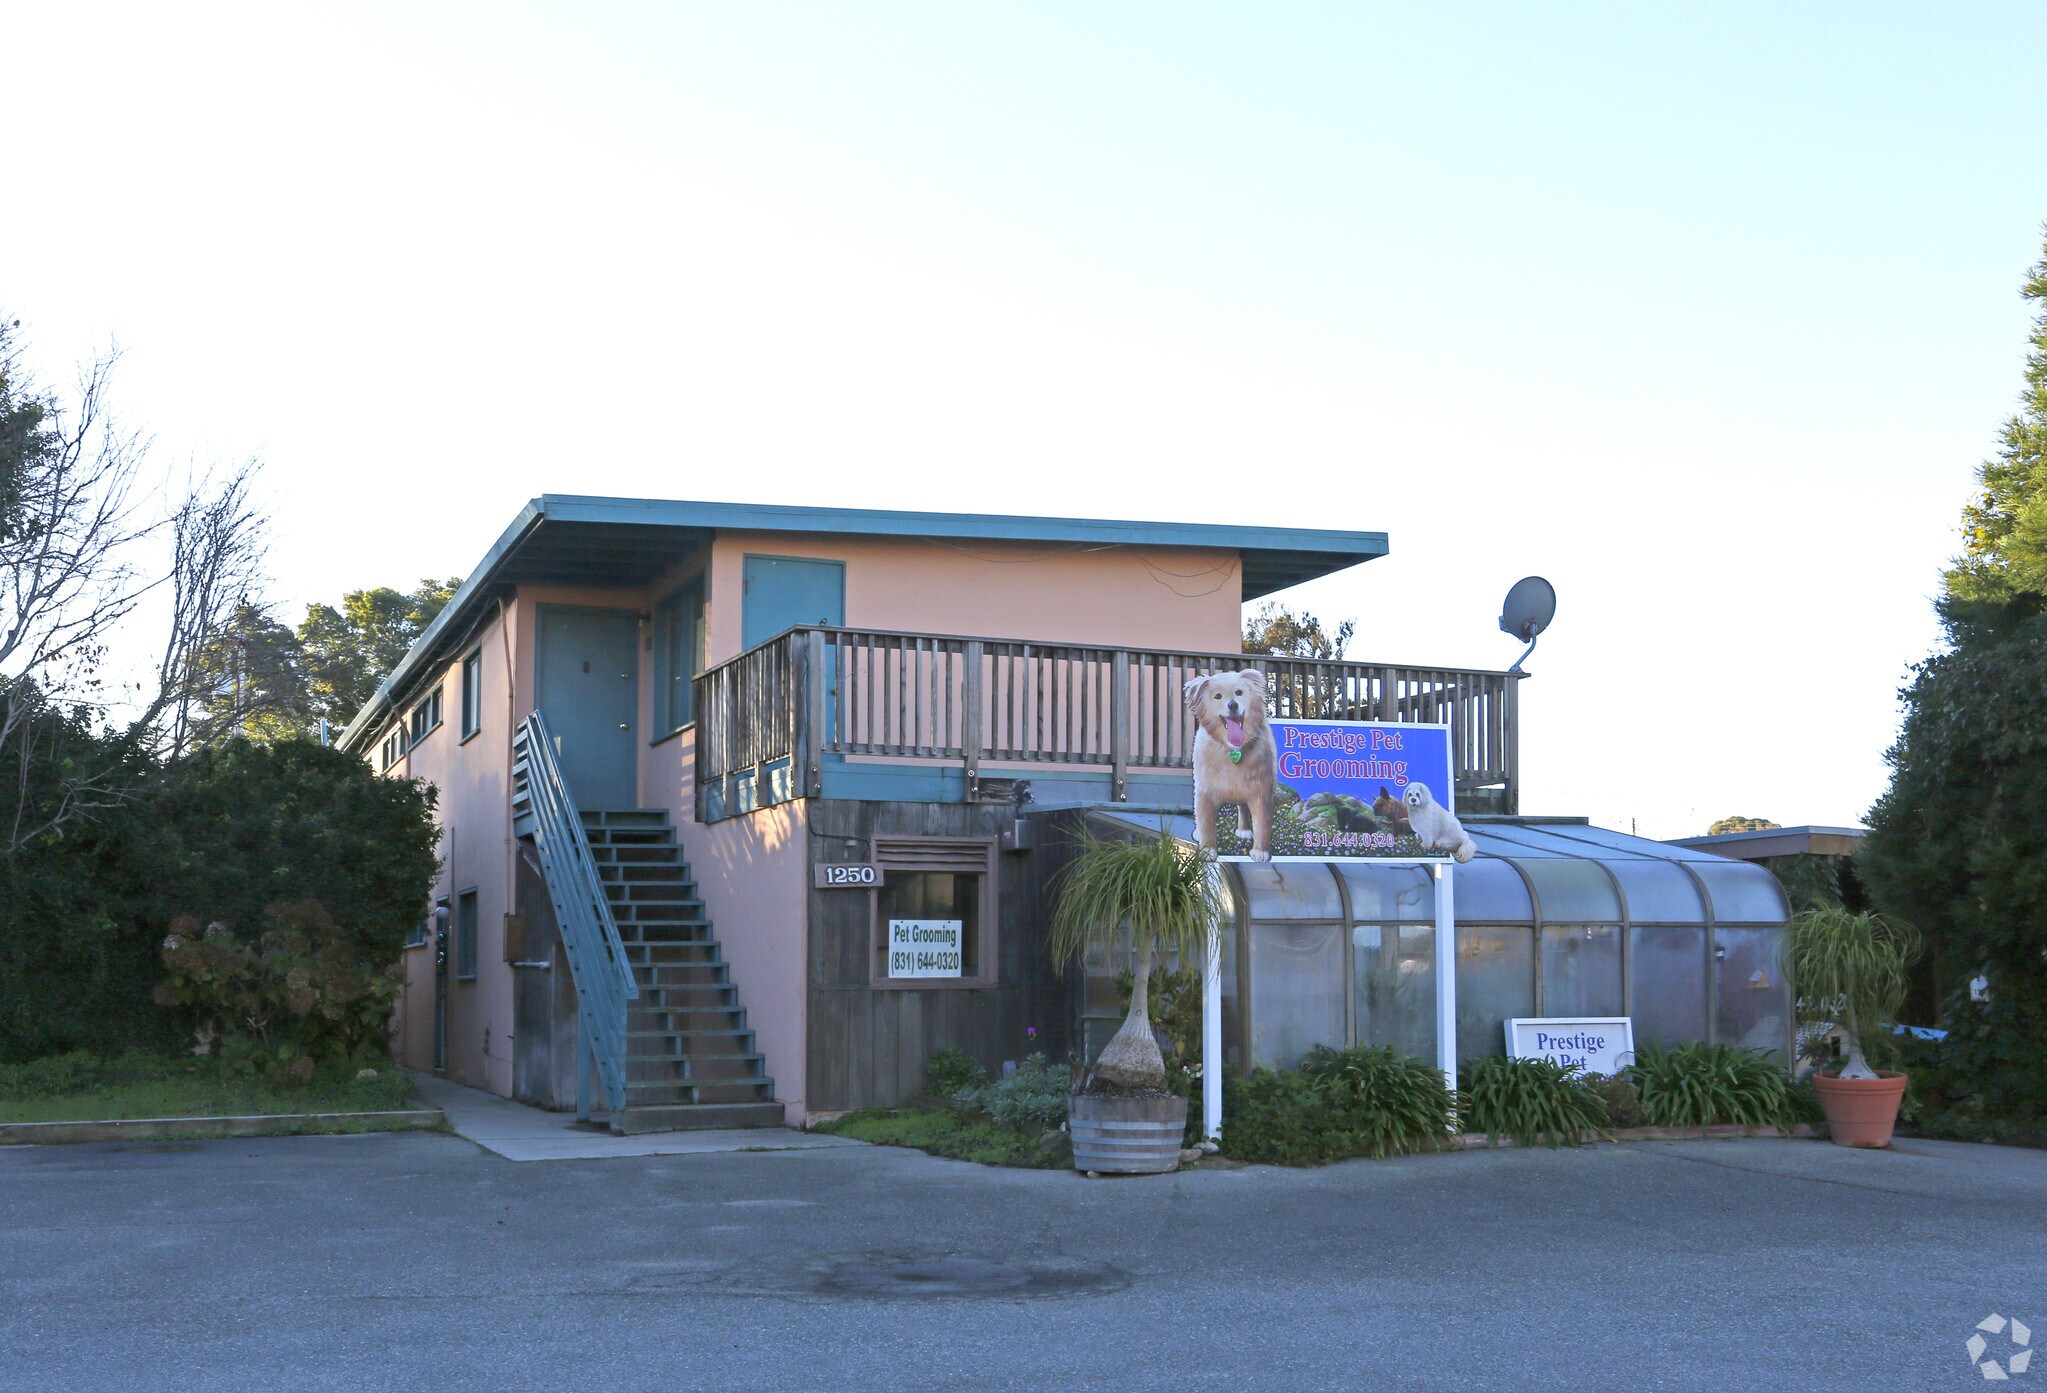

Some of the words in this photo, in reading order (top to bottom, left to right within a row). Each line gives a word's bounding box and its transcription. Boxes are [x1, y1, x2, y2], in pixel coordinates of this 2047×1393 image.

[1284, 727, 1366, 754] Prestige
[1371, 730, 1403, 750] Pet
[1279, 752, 1408, 786] Grooming
[1304, 832, 1395, 848] 831.644.0320
[826, 867, 875, 884] 1250
[894, 924, 909, 943] Pet
[912, 925, 957, 947] Grooming
[891, 952, 915, 975] (831)
[917, 952, 959, 971] 644-0320
[1536, 1032, 1605, 1054] Prestige
